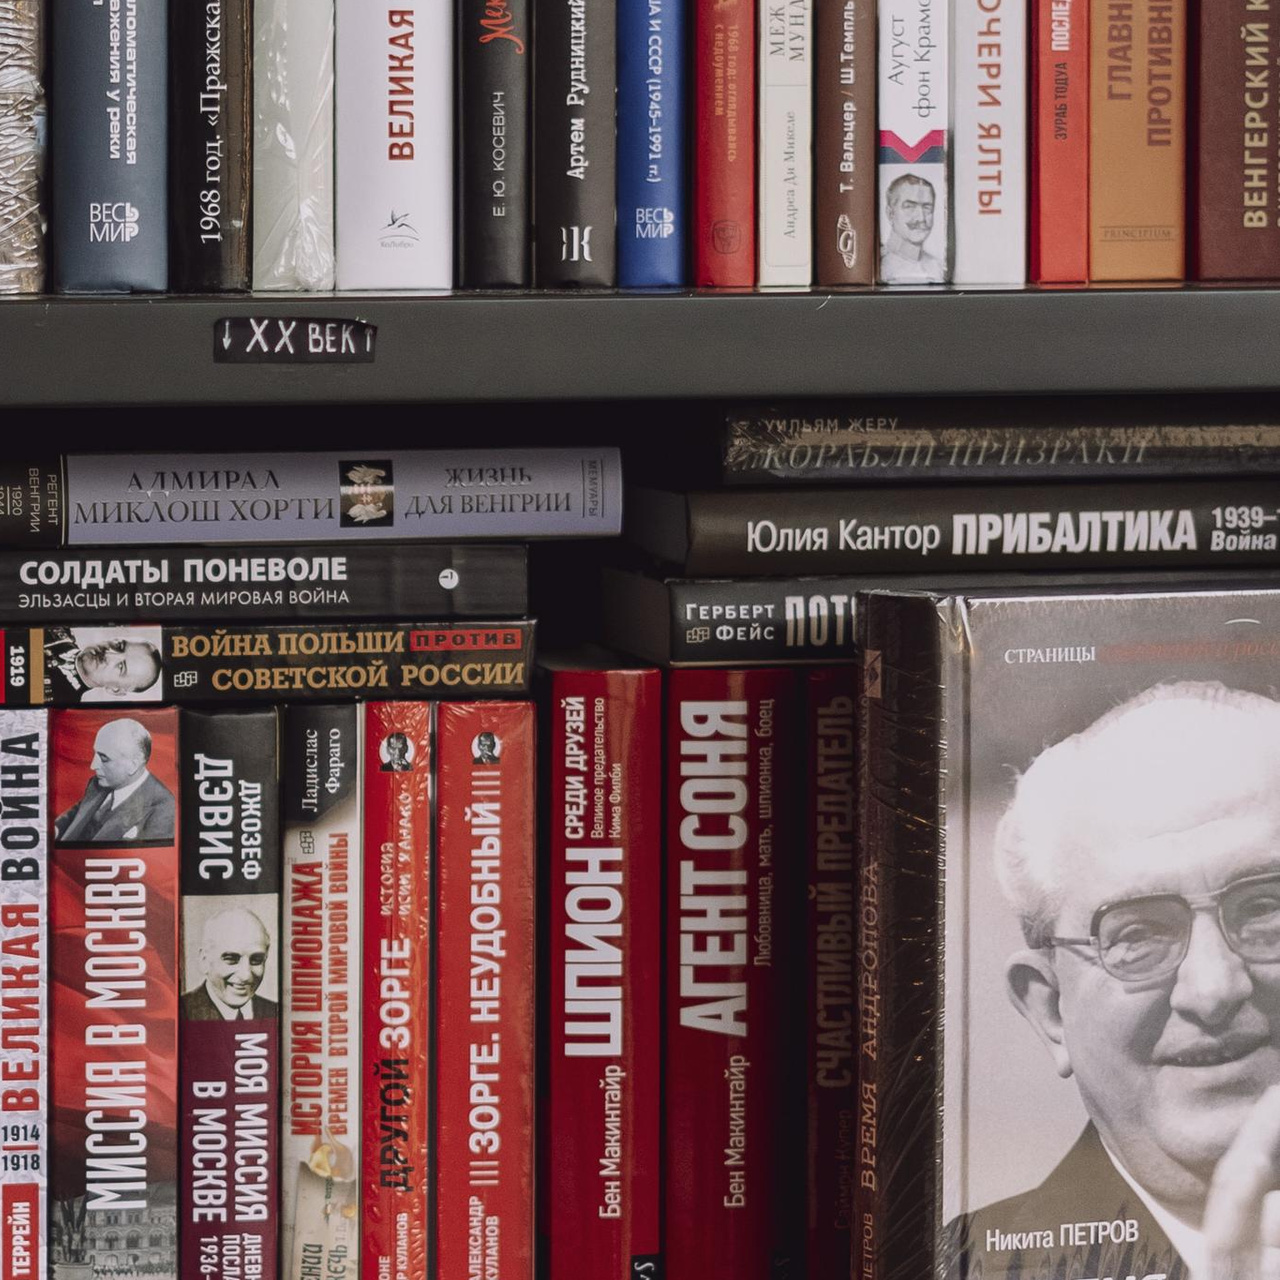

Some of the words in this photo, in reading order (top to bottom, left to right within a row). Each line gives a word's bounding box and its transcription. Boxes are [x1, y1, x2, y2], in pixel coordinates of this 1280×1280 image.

[387, 9, 414, 161] ВЕЛИКАЯ
[203, 134, 223, 182] год.
[1240, 23, 1269, 227] ВЕНГЕРСКИЙ
[977, 122, 1001, 215] ЯЛТЫ
[199, 190, 222, 243] 1968
[308, 323, 355, 354] ВЕК
[747, 521, 828, 552] Юлия
[839, 520, 941, 557] Кантор
[952, 509, 1197, 555] ПРИБАЛТИКА
[19, 557, 169, 588] СОЛДАТЫ
[183, 556, 347, 584] ПОНЕВОЛЕ
[171, 632, 272, 658] ВОЙНА
[278, 631, 405, 655] ПОЛЬШИ
[415, 631, 516, 648] ПРОТИВ
[686, 602, 775, 621] ГЕРБЕРТ
[715, 623, 775, 641] ФЕЙС
[211, 661, 388, 691] СОВЕТСКОЙ
[401, 662, 524, 688] РОССИИ
[1004, 646, 1096, 664] СТРАНИЦЫ
[324, 728, 345, 794] Фараго
[561, 697, 587, 771] ДРУЗЕЙ
[592, 698, 607, 785] предательство
[301, 729, 319, 813] Ладислас
[609, 763, 622, 804] Филби
[679, 700, 748, 850] СОНЯ
[565, 776, 587, 839] СРЕДИ
[591, 788, 605, 838] Великое
[609, 806, 622, 838] Кима
[85, 858, 147, 1009] МОСКВУ
[290, 861, 323, 1012] ШПИОНАЖА
[466, 802, 506, 1021] НЕУДОБНЫЙ
[565, 847, 623, 1056] ШПИОН
[679, 860, 748, 1037] АГЕНТ
[1, 904, 40, 1111] ВЕЛИКАЯ
[85, 1024, 147, 1046] В
[192, 1081, 227, 1098] В
[234, 1032, 268, 1093] МОЯ
[290, 1021, 323, 1136] ИСТОРИЯ
[468, 1033, 500, 1154] ЗОРГЕ.
[86, 1061, 148, 1210] МИССИЯ
[599, 1065, 625, 1176] Макинтайр
[192, 1108, 228, 1223] МОСКВЕ
[234, 1103, 268, 1221] МИССИЯ
[599, 1181, 621, 1218] Бен
[7, 1201, 31, 1277] ТЕРРЕЙН
[986, 1225, 1054, 1252] Никита
[1058, 1218, 1139, 1247] ПЕТРОВ
